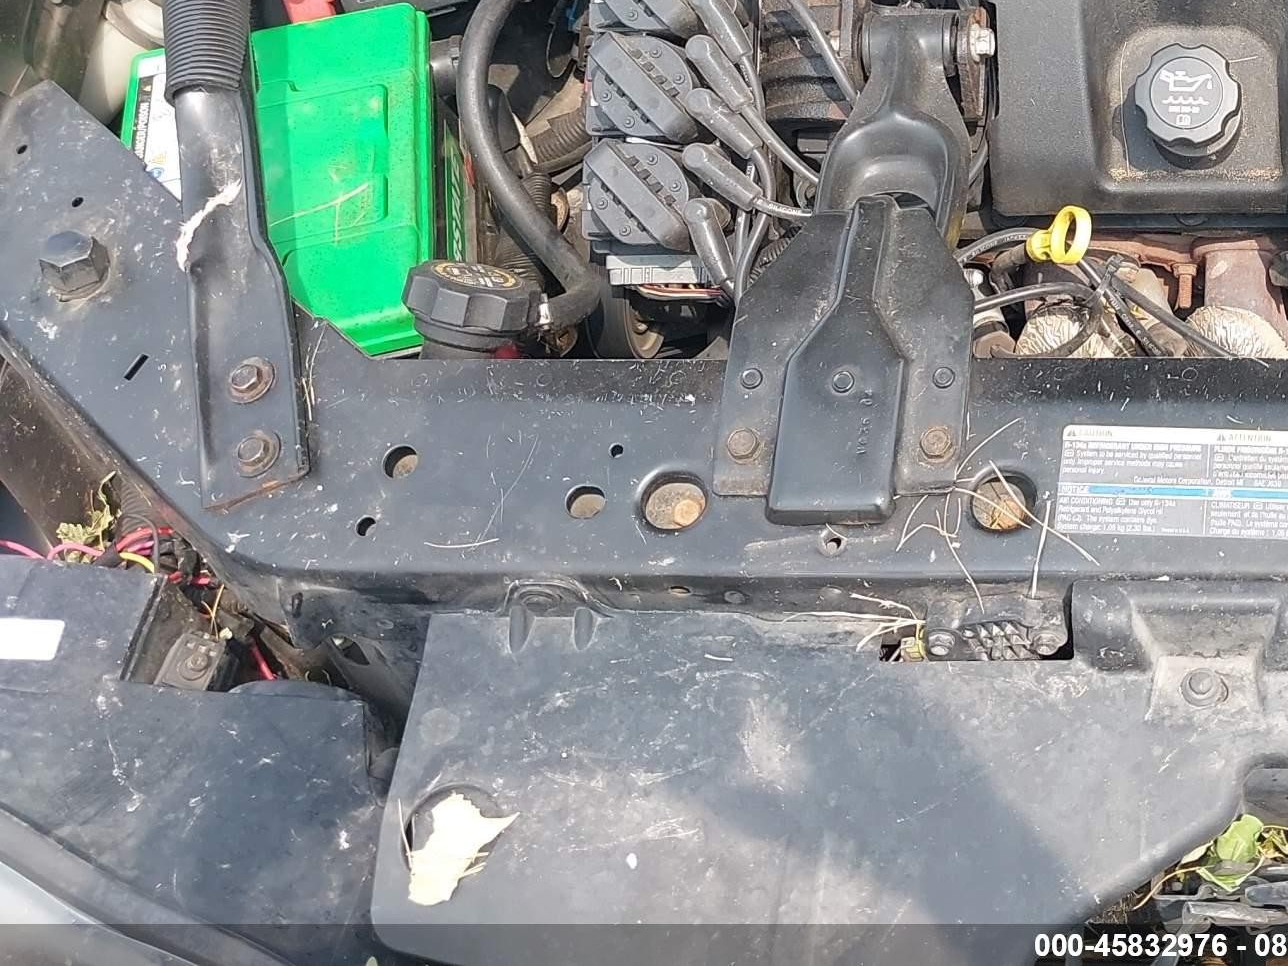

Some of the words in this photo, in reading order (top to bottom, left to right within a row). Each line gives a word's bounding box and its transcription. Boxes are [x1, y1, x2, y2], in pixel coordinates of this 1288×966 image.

[1228, 434, 1272, 442] ATTENTION
[1157, 475, 1177, 484] Motors
[1061, 485, 1089, 494] NOTICE
